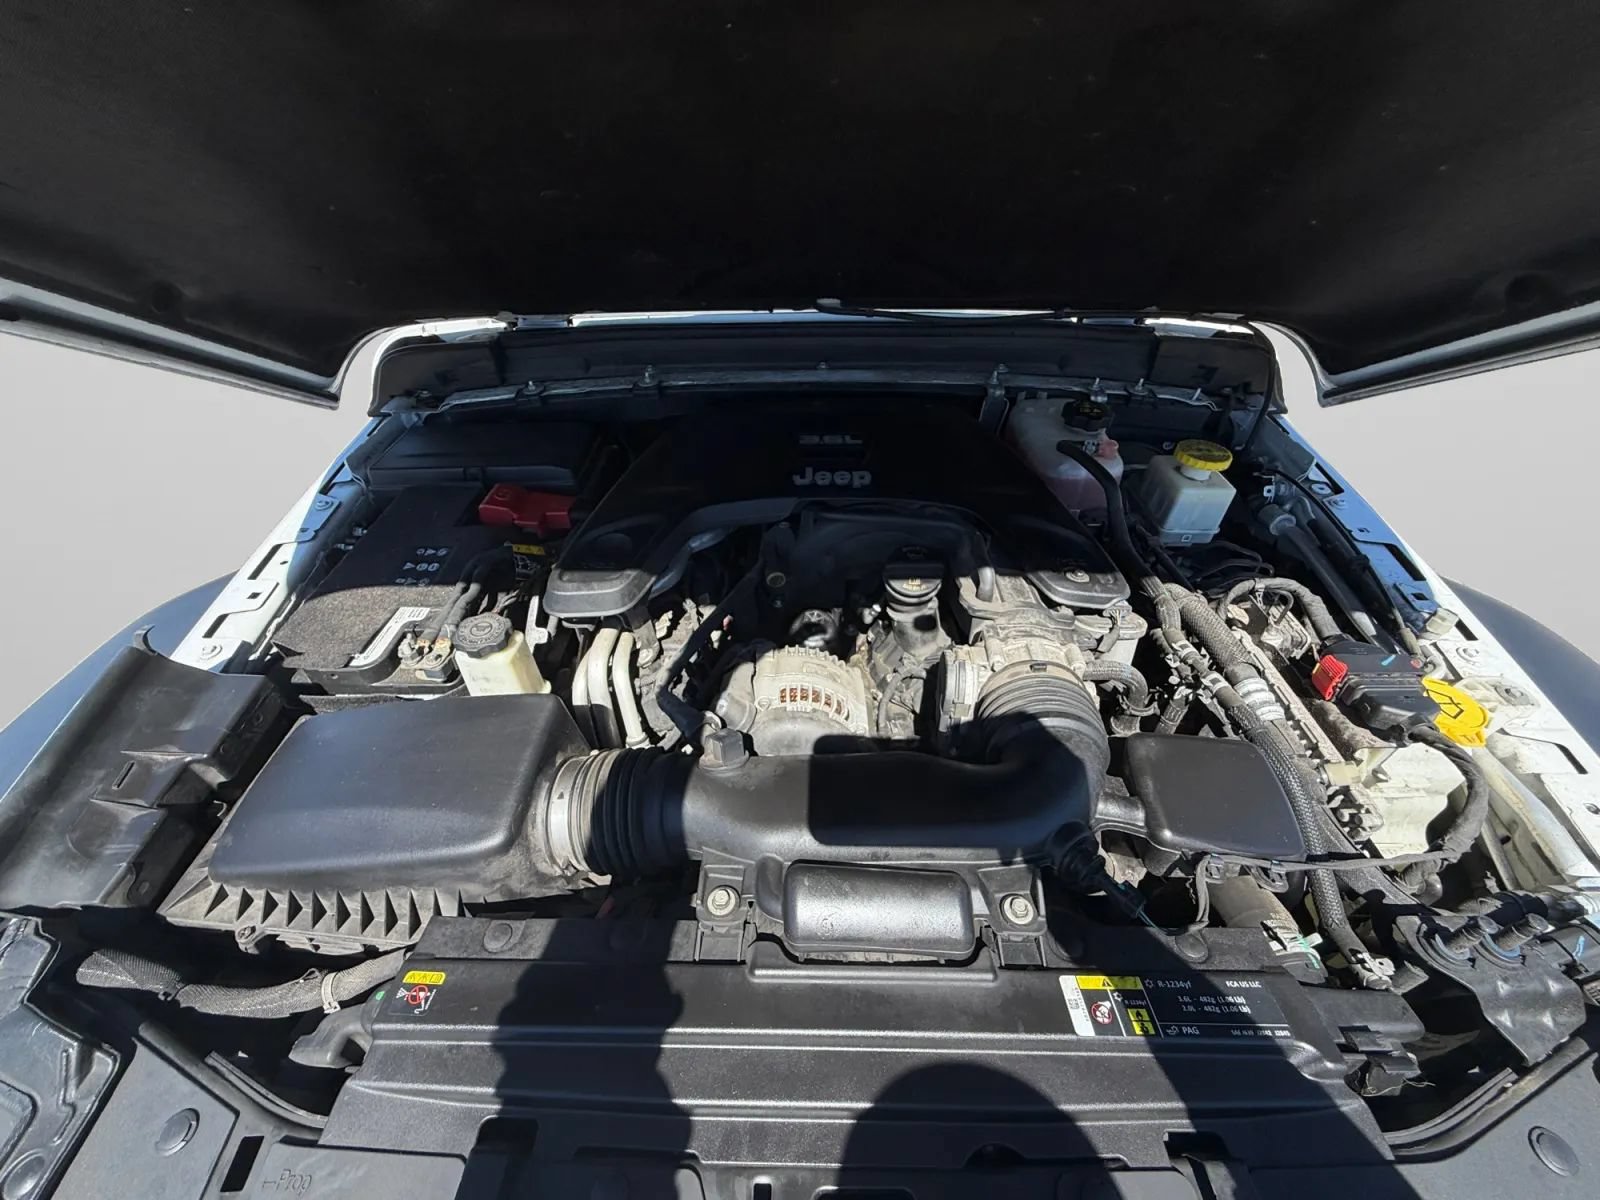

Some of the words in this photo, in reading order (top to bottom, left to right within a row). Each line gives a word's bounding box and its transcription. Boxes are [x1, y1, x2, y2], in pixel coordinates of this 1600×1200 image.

[792, 466, 872, 489] Jeep
[1159, 980, 1192, 989] R-1234yf
[1225, 980, 1239, 988] FCA
[1240, 980, 1249, 988] US
[1182, 1026, 1199, 1035] PAG
